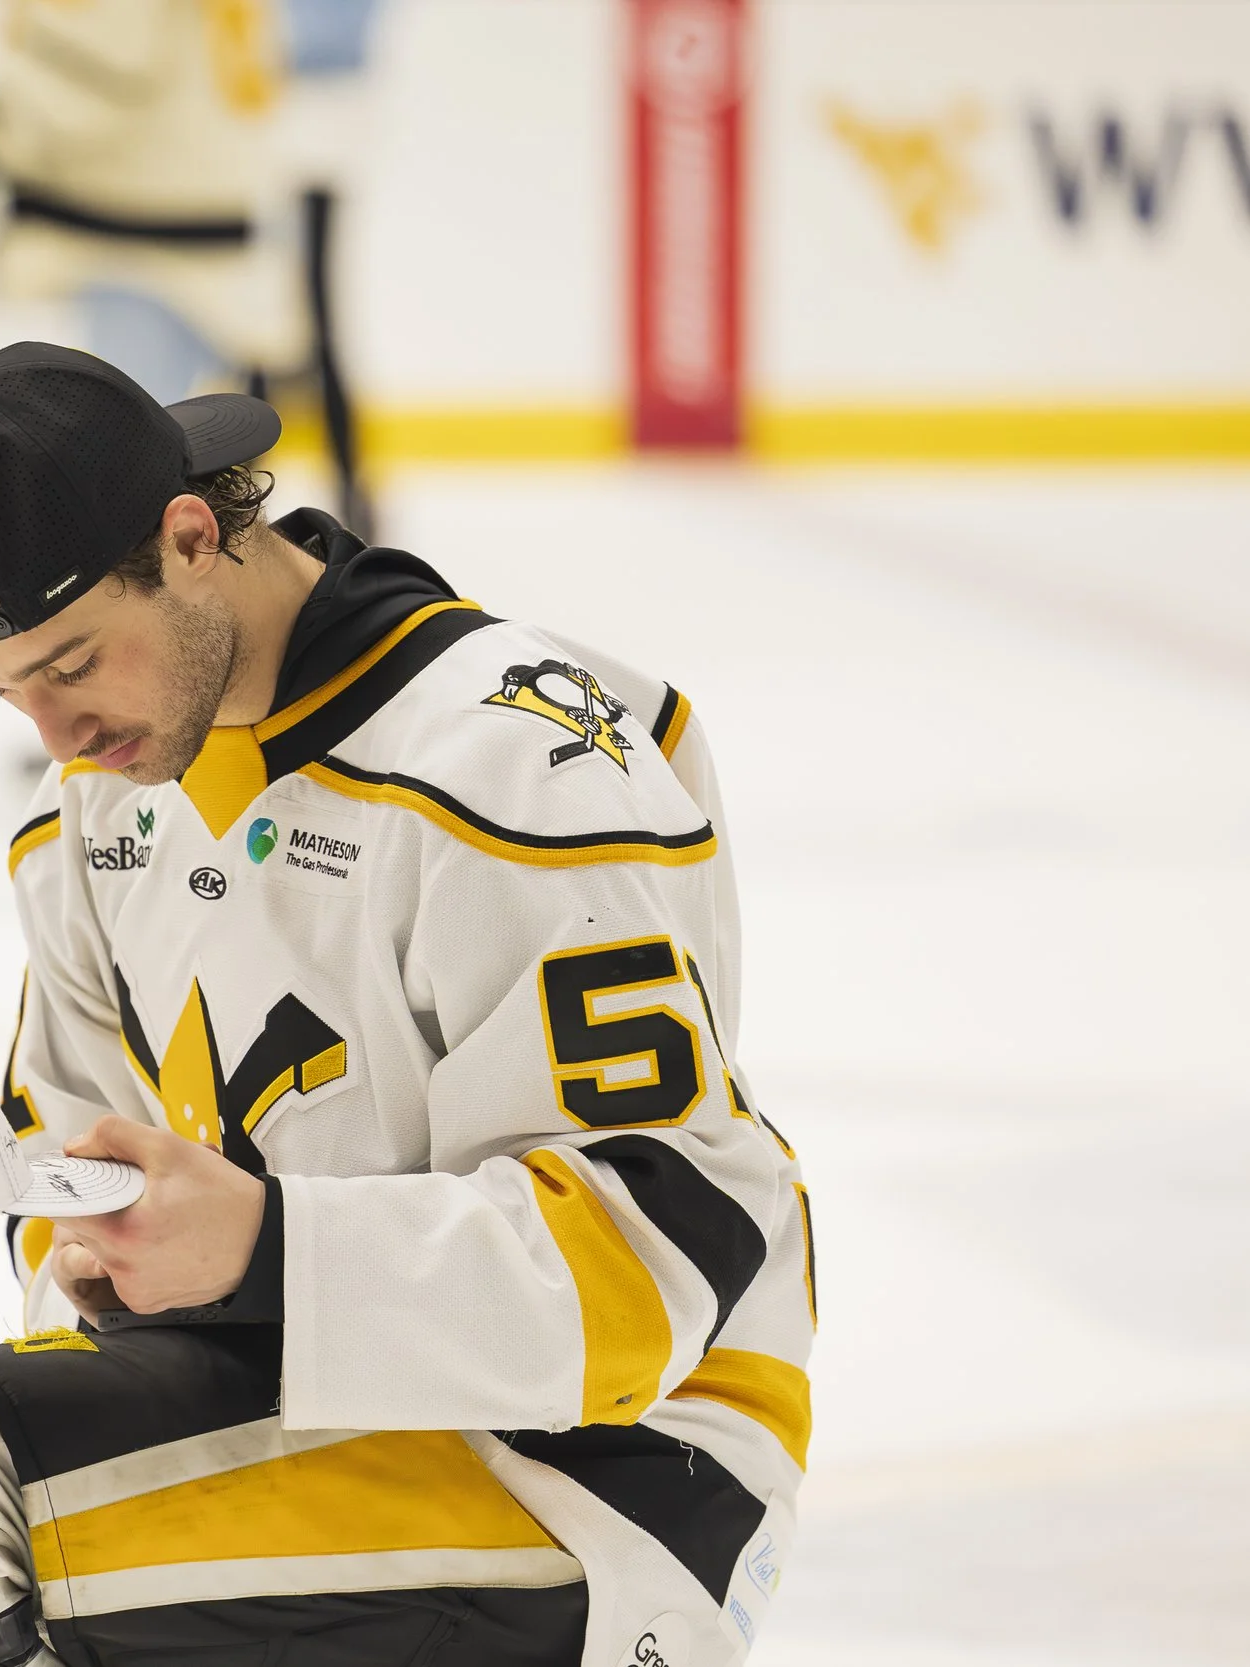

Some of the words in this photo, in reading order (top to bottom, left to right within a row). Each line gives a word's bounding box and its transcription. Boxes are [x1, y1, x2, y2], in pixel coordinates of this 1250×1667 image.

[289, 828, 361, 862] MATHESON
[286, 852, 301, 867] The
[302, 857, 315, 871] Gas
